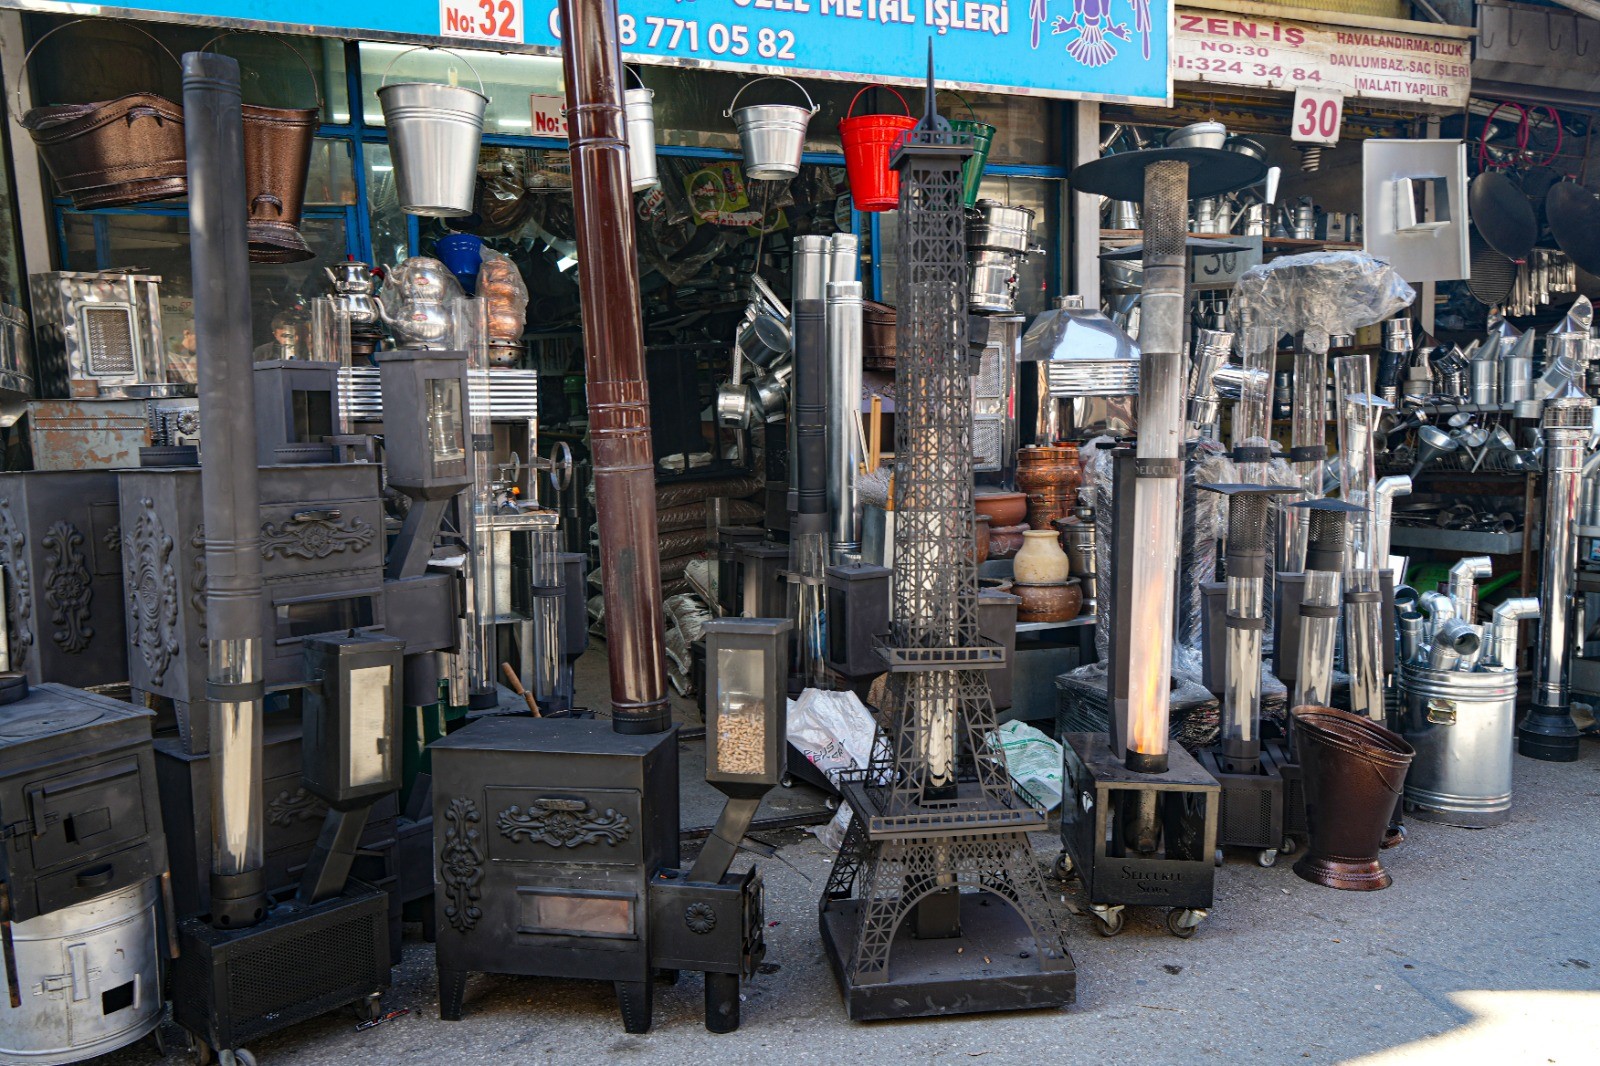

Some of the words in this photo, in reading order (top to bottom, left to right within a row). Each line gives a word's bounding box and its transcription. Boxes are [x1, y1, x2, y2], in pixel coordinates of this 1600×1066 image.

[446, 7, 475, 33] No:
[479, 0, 516, 38] 32
[820, 0, 916, 24] METAL
[646, 16, 699, 52] 771
[708, 22, 750, 56] 05
[757, 27, 797, 60] 82
[1174, 15, 1305, 48] ZEN-İŞ
[1200, 41, 1269, 57] NO:30
[1253, 63, 1283, 79] 34
[1292, 68, 1322, 82] 84
[1405, 82, 1449, 97] YAPILIR
[535, 111, 559, 132] No:
[1298, 98, 1338, 137] 30
